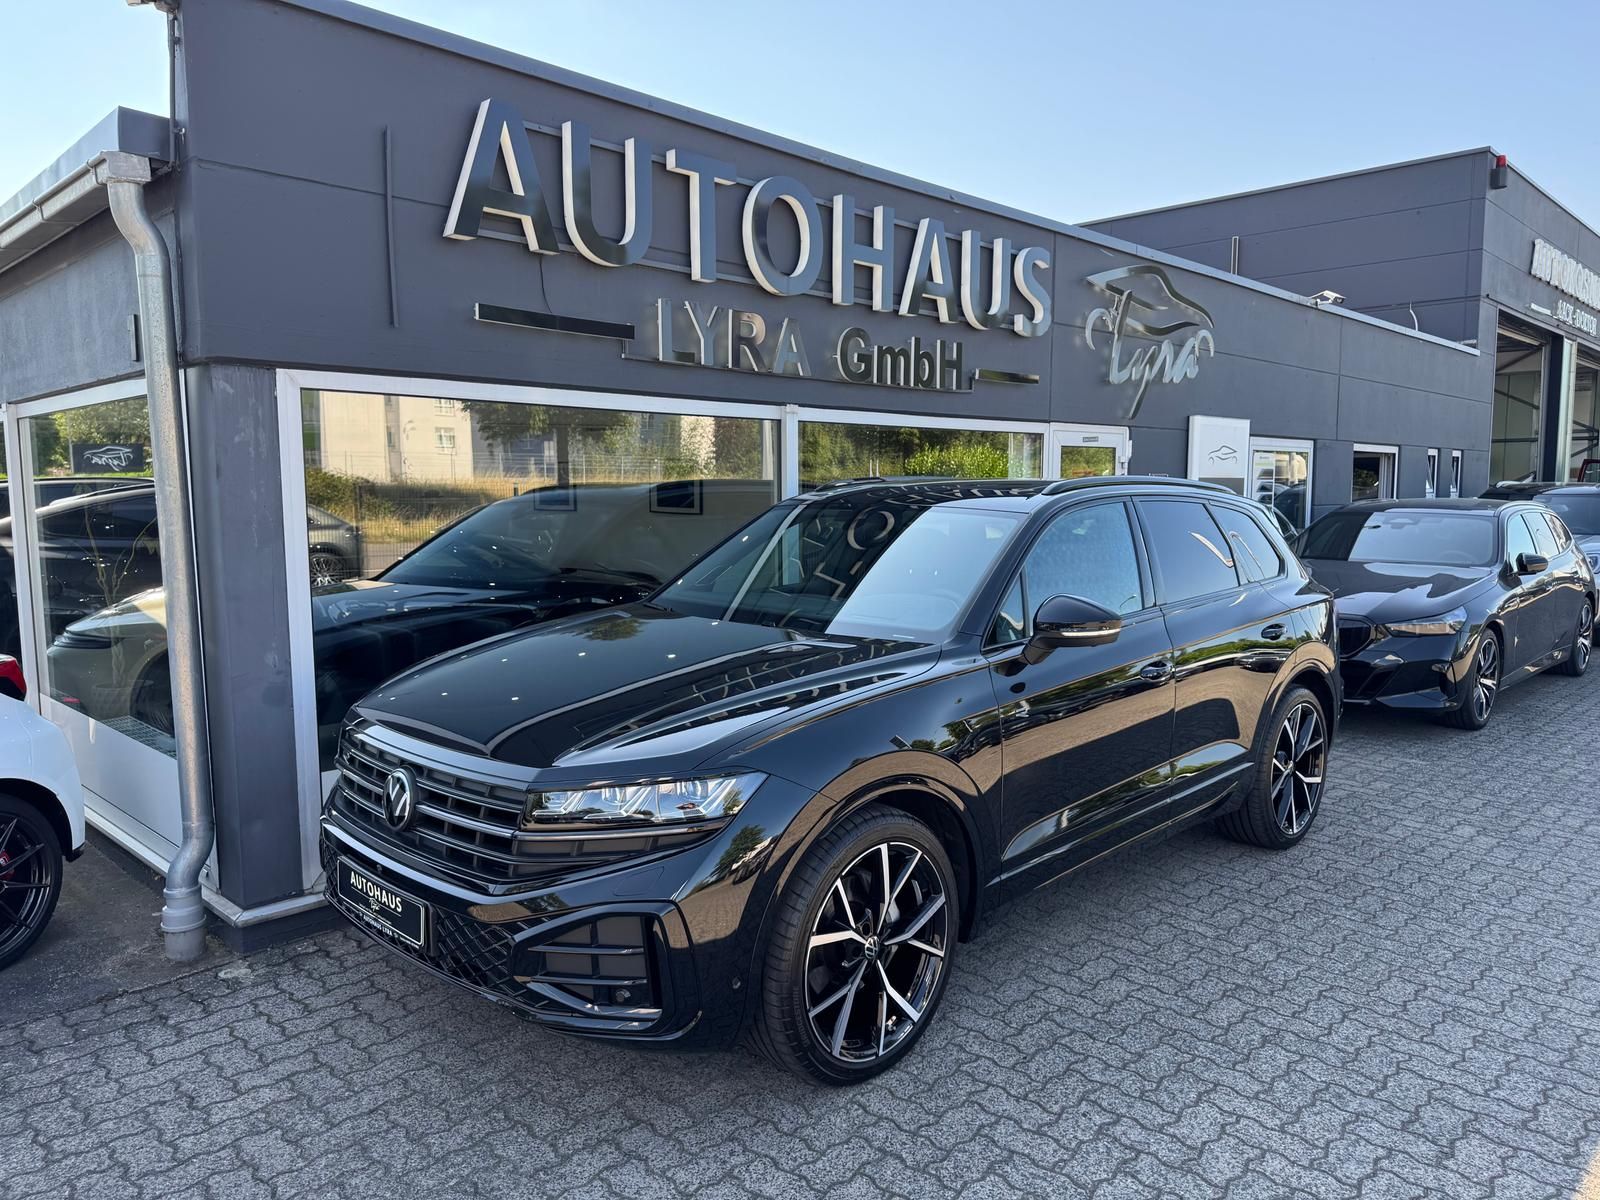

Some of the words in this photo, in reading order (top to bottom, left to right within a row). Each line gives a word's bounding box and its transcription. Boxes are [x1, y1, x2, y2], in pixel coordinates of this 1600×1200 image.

[442, 98, 1052, 338] AUTOHAUS
[657, 297, 812, 377] LYRA
[835, 326, 964, 391] GmbH
[350, 871, 402, 912] AUTOHAUS
